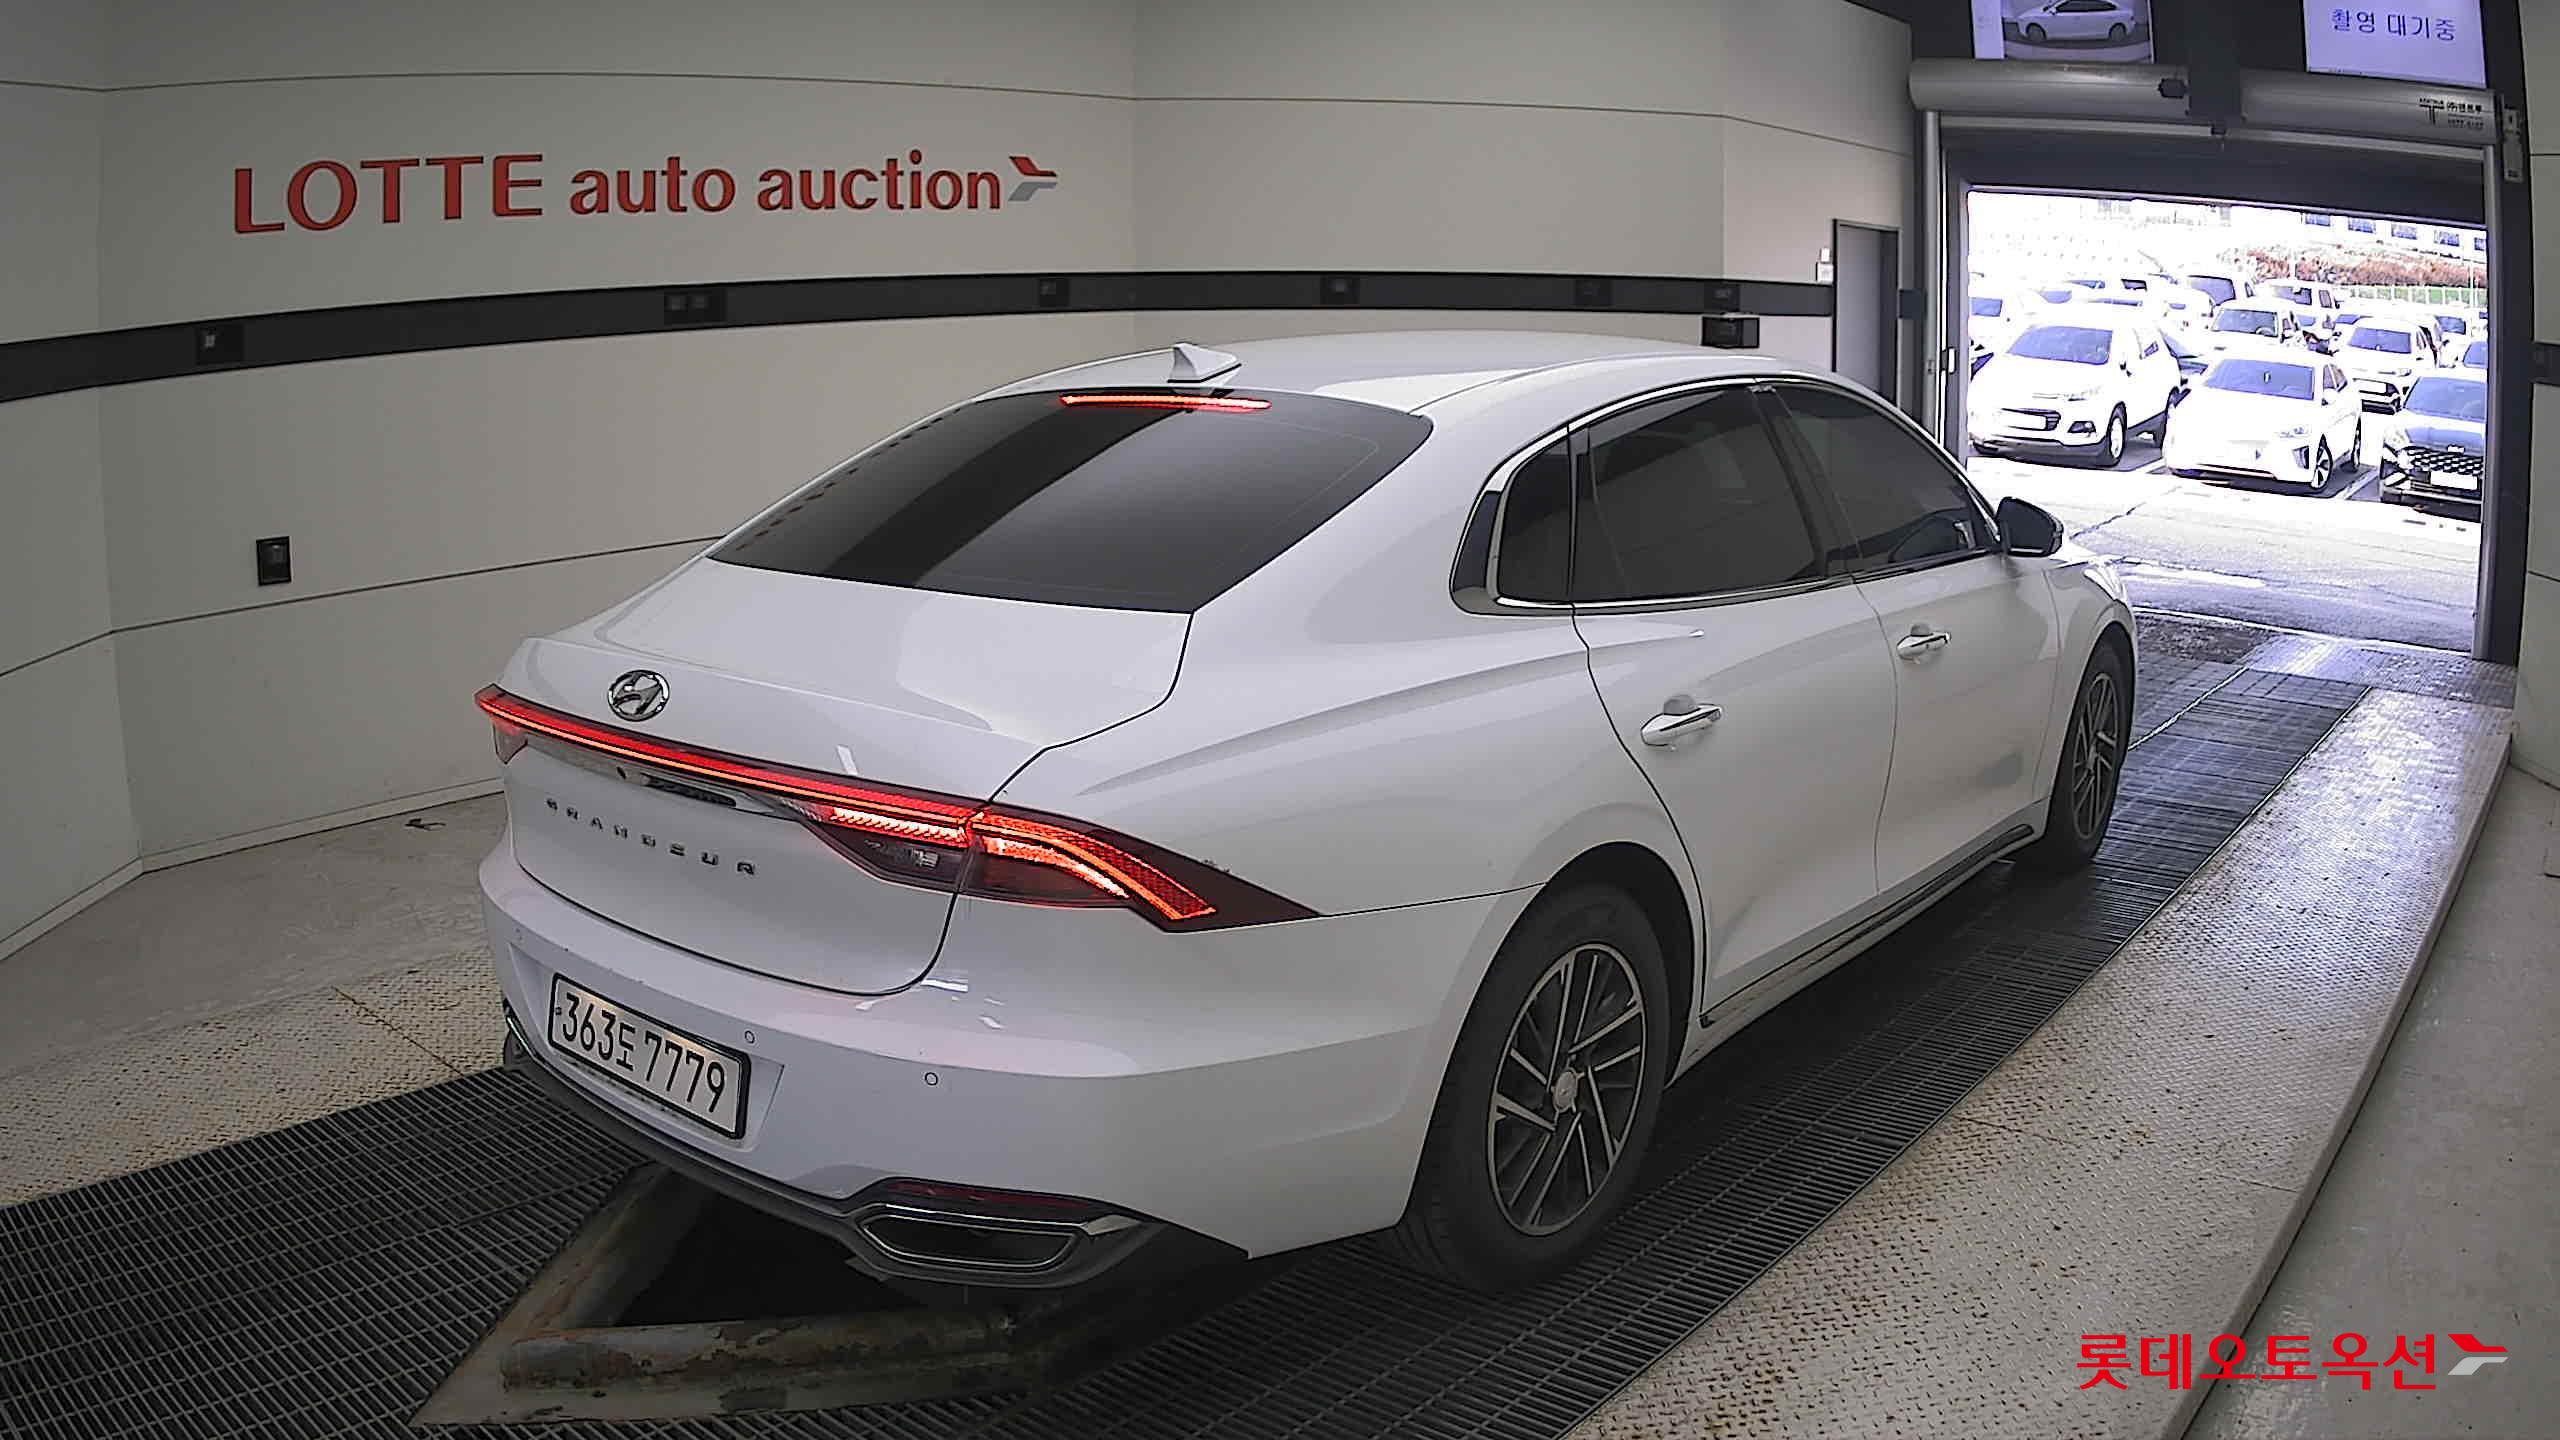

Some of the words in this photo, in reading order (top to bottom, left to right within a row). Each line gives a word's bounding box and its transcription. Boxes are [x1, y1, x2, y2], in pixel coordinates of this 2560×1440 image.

[2331, 8, 2376, 34] 촬영
[2387, 14, 2456, 42] 대기중
[234, 154, 543, 234] LOTTE
[569, 156, 737, 215] auto
[758, 149, 1000, 211] auction
